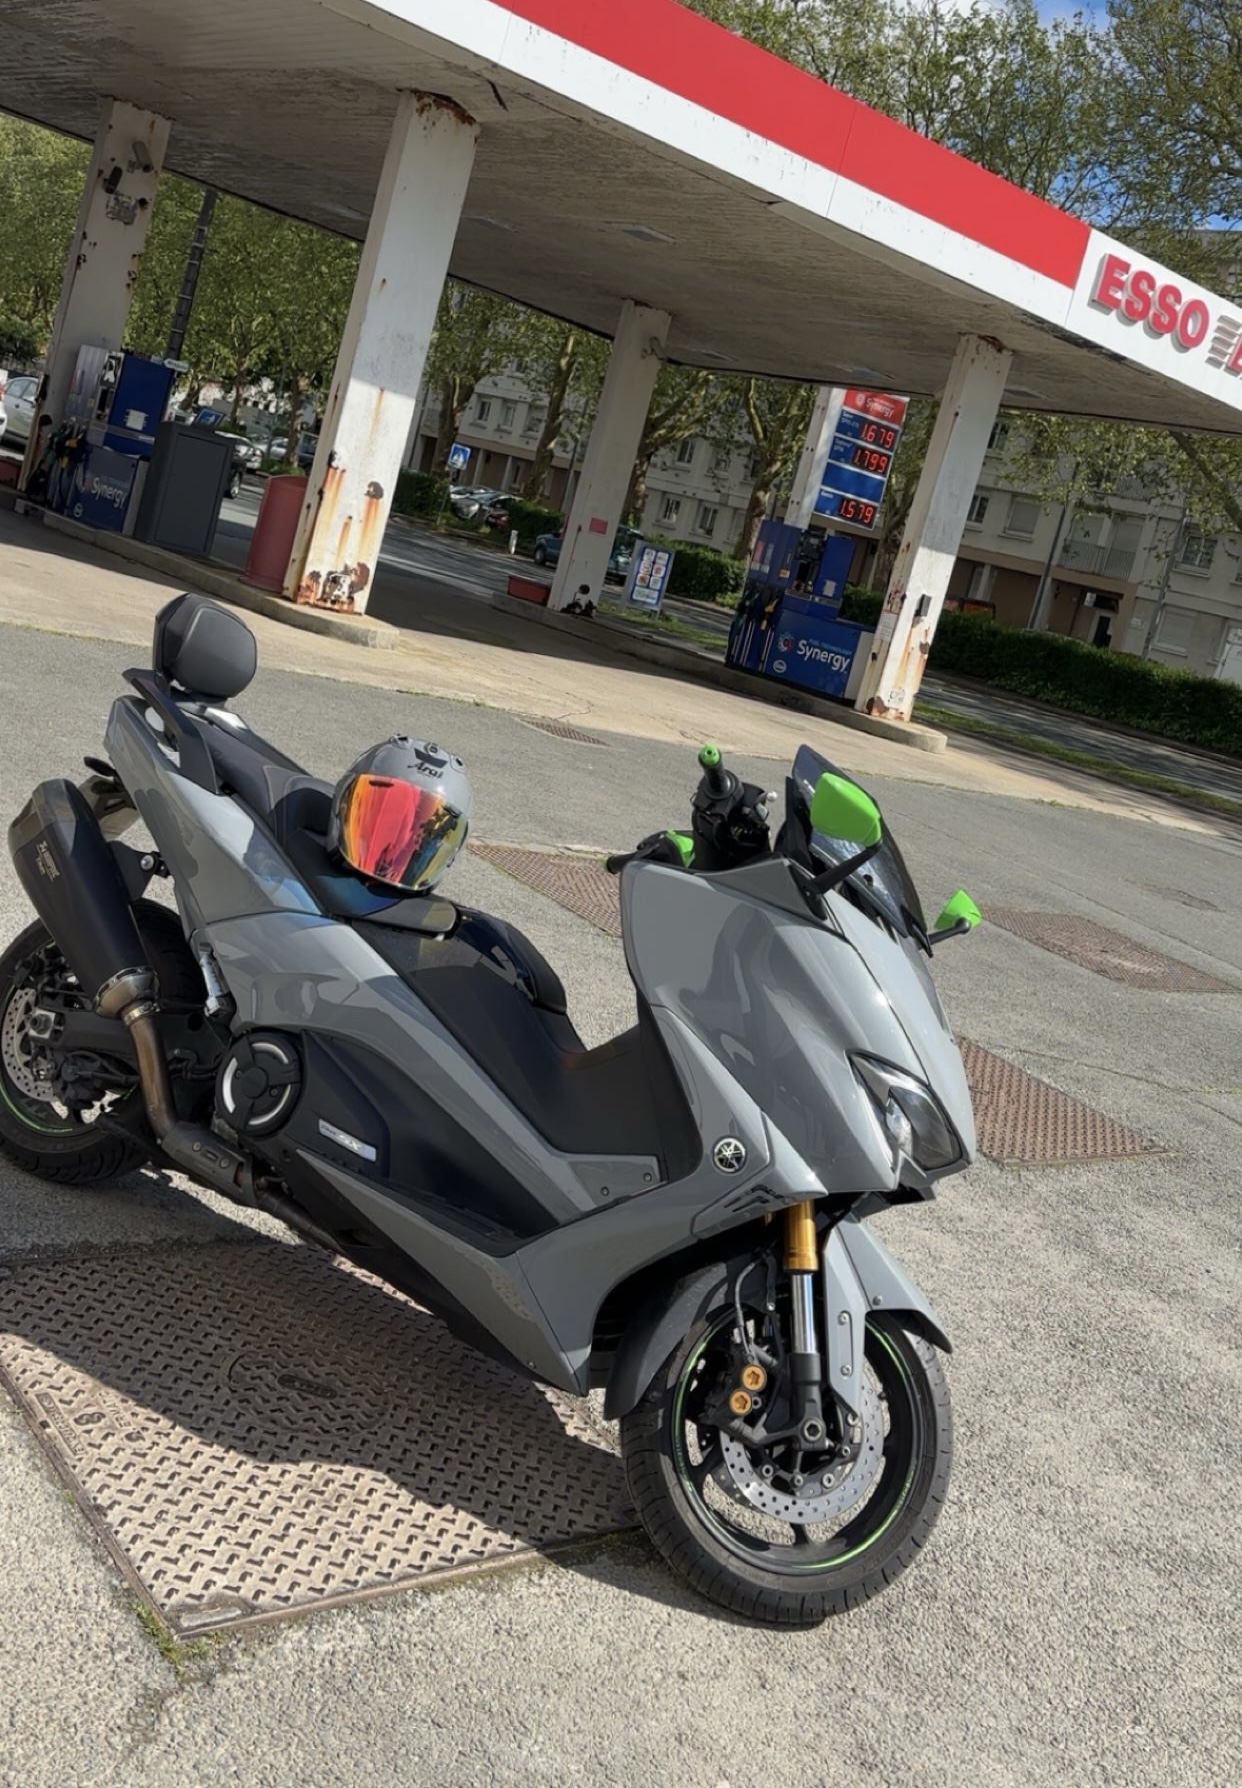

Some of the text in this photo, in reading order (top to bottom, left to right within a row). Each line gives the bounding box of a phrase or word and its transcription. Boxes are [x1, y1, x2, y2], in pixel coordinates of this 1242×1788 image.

[1093, 253, 1210, 349] ESSO
[861, 423, 895, 449] 1.679
[854, 449, 889, 473] 1.799
[91, 477, 128, 508] Synergy
[840, 500, 874, 524] 1.579
[797, 639, 850, 672] Synergy
[407, 762, 443, 778] Arai
